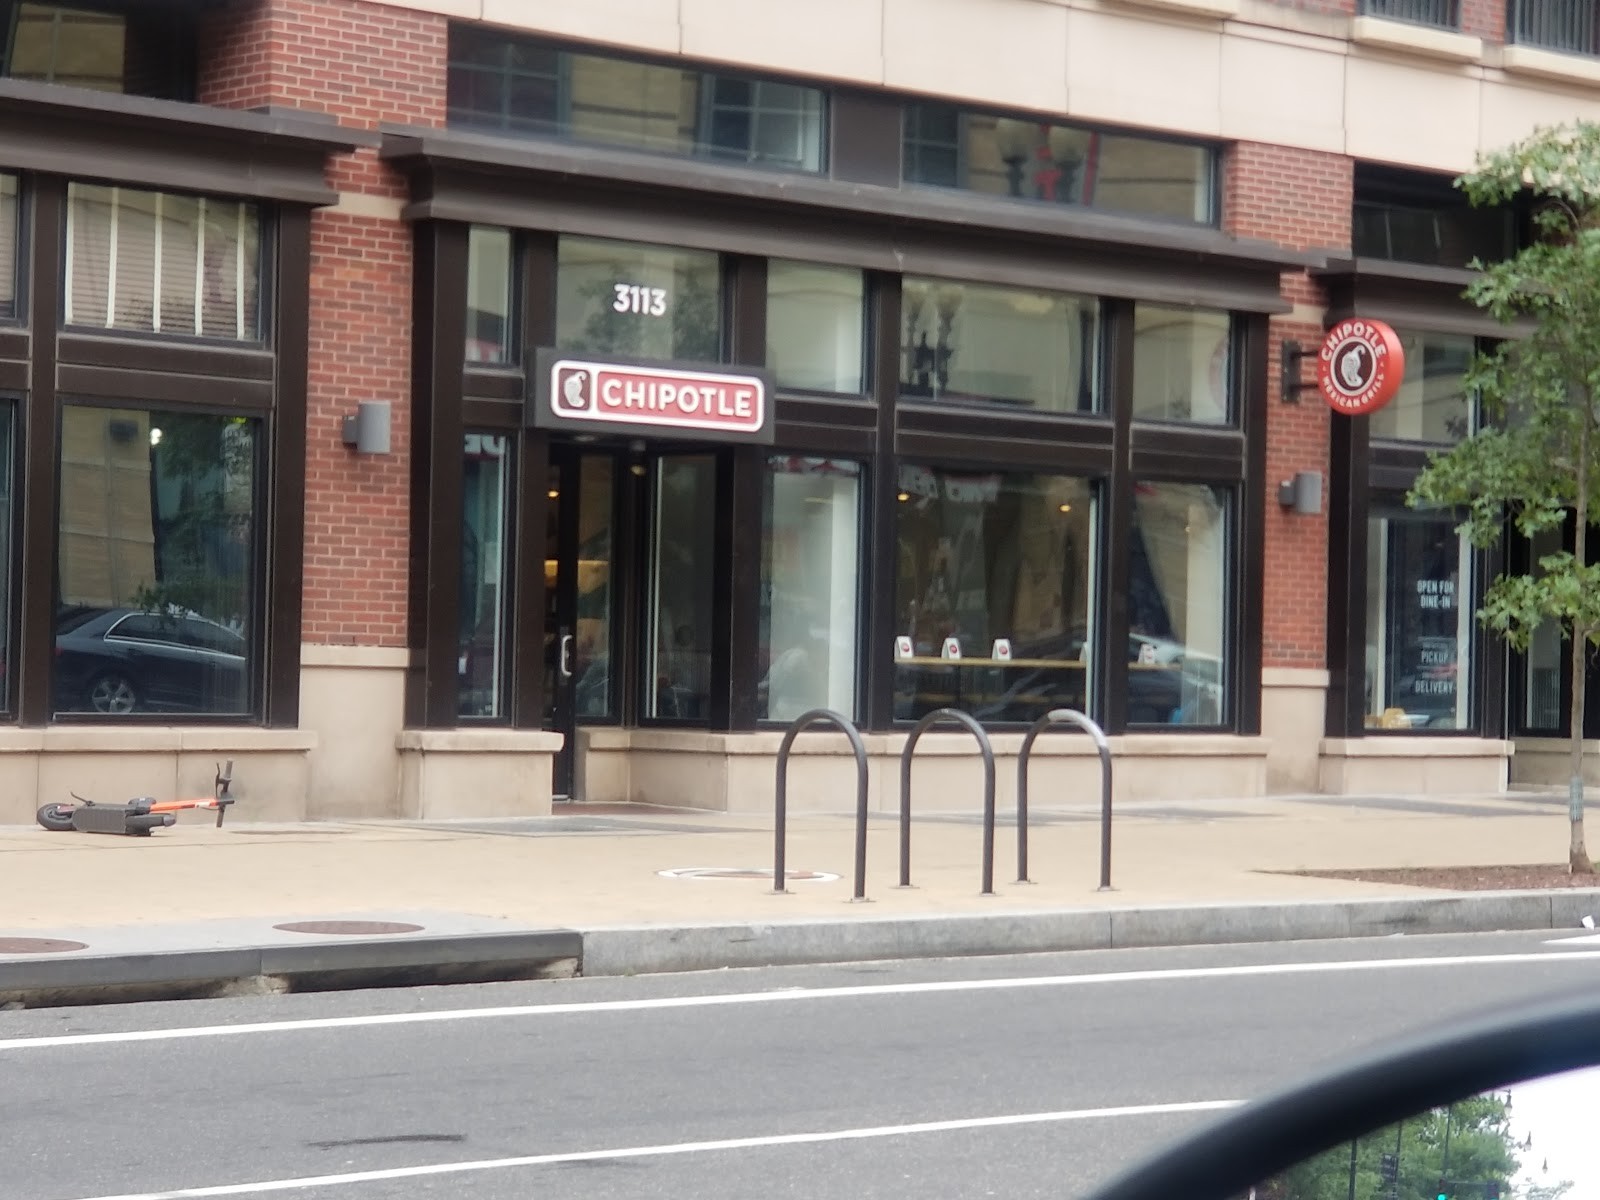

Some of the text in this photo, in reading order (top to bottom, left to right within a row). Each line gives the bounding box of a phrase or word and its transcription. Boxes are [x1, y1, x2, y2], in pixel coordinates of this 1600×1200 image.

[613, 283, 667, 317] 3113
[1321, 322, 1387, 361] CHIPOTLE
[602, 378, 752, 418] CHIPOTLE
[1323, 374, 1385, 408] MEXICAN GRILL
[1417, 580, 1455, 594] OPEN FOR
[1421, 650, 1449, 664] PICKUP
[1415, 680, 1454, 695] DELIVERY
